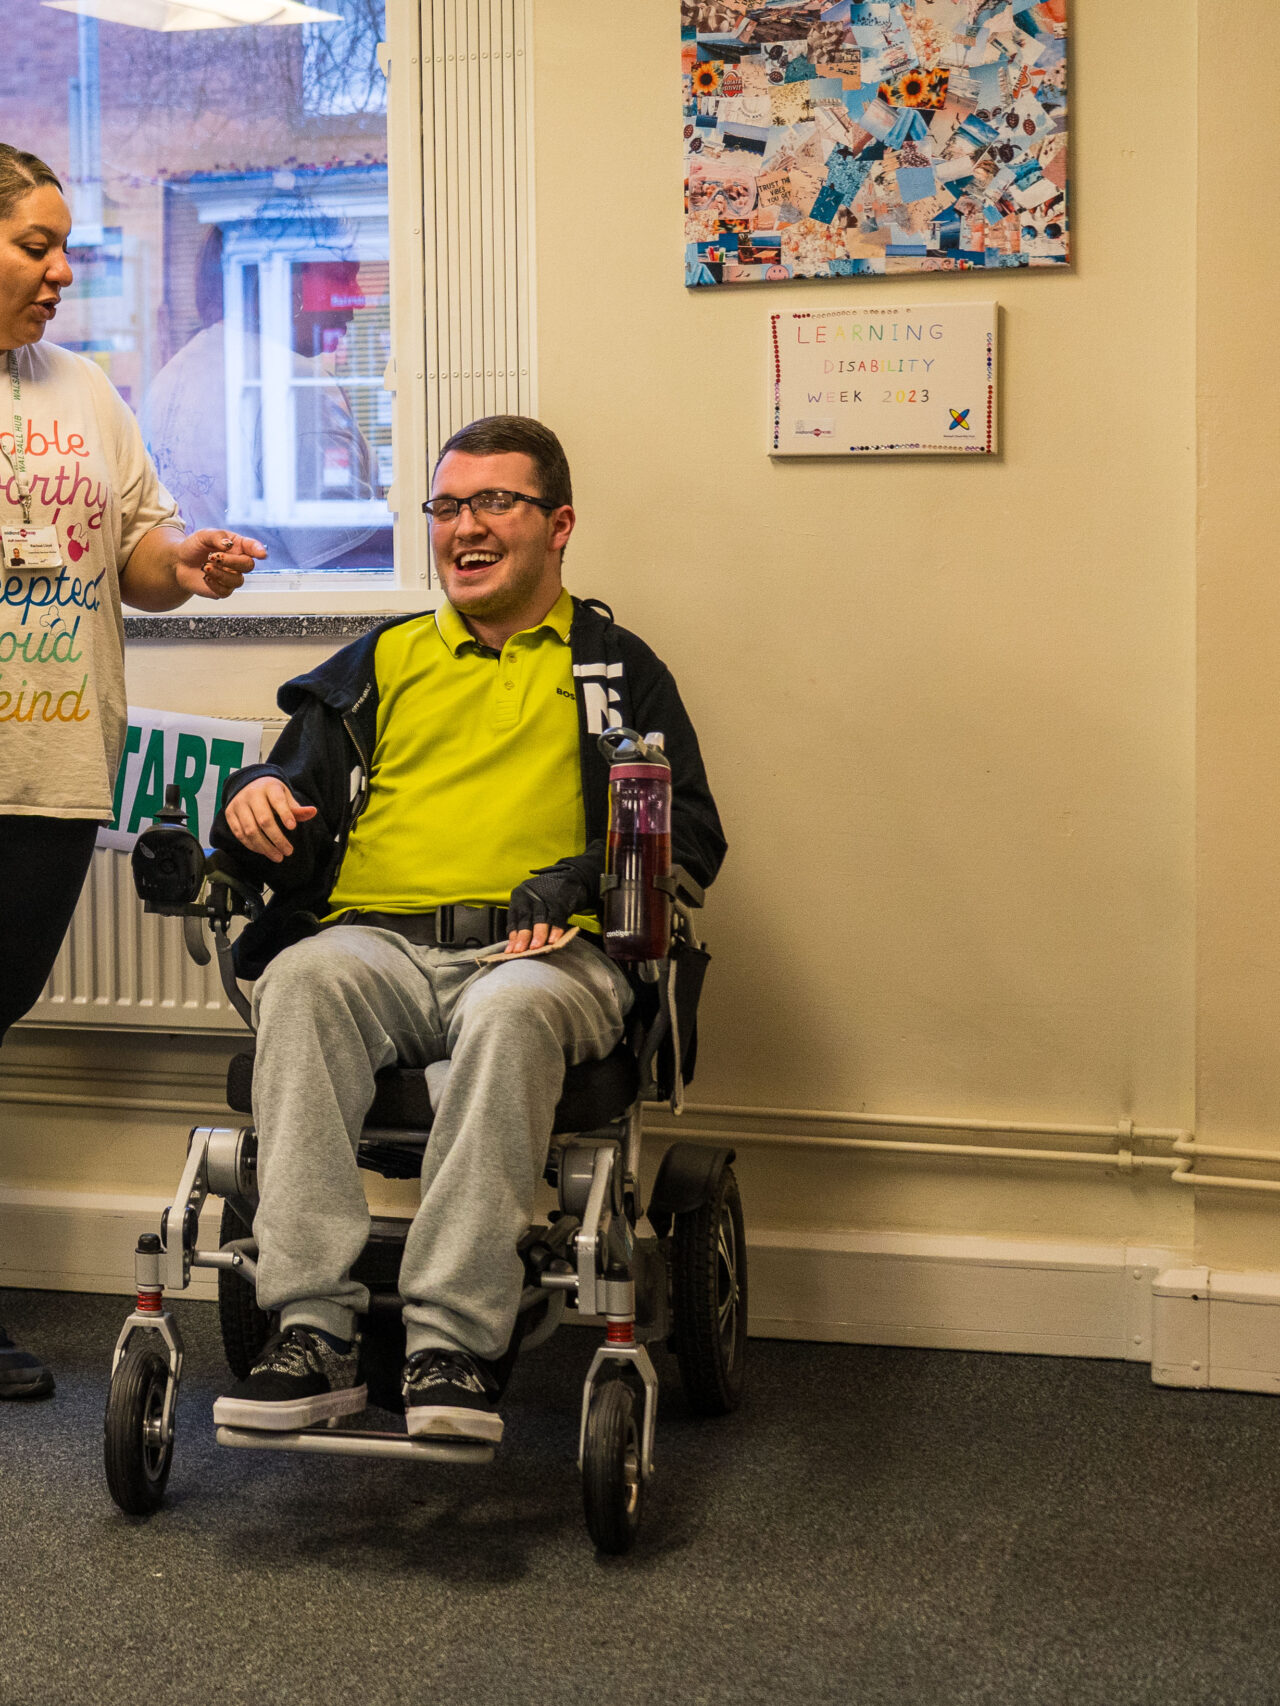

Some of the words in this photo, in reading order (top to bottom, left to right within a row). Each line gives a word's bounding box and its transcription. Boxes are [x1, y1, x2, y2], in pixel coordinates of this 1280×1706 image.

[797, 323, 944, 344] LEARNING
[823, 358, 936, 375] DISABILITY
[9, 366, 22, 401] WALSALL
[807, 390, 863, 403] WEEK
[881, 389, 930, 403] 2023
[14, 415, 23, 434] HUB
[16, 433, 26, 473] WALSALL
[556, 687, 576, 701] BOS
[108, 725, 245, 841] TART
